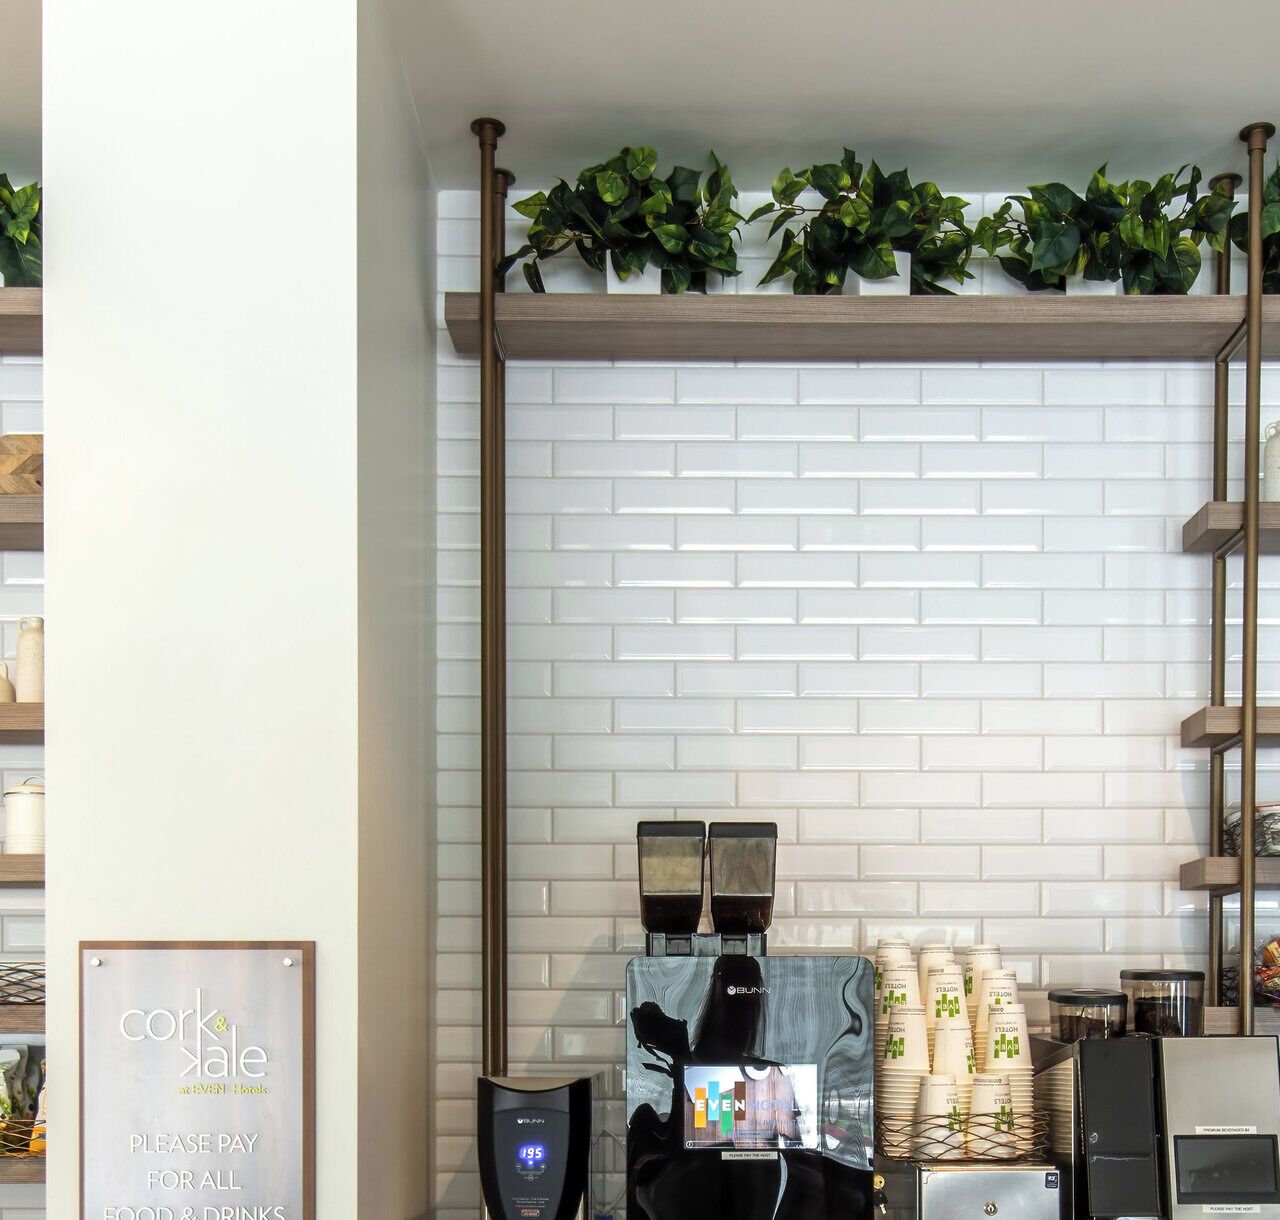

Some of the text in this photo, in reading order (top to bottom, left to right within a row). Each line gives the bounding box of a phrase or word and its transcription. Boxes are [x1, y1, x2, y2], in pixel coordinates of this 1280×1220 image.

[736, 986, 770, 994] BUNN
[120, 988, 229, 1041] cork &
[179, 1024, 269, 1078] kale
[192, 1084, 225, 1095] EVEN
[233, 1083, 268, 1095] Hotels
[696, 1100, 746, 1111] EVEN
[130, 1134, 260, 1154] PLEASE PAY
[522, 1147, 542, 1159] 195
[147, 1170, 243, 1190] FOR ALL
